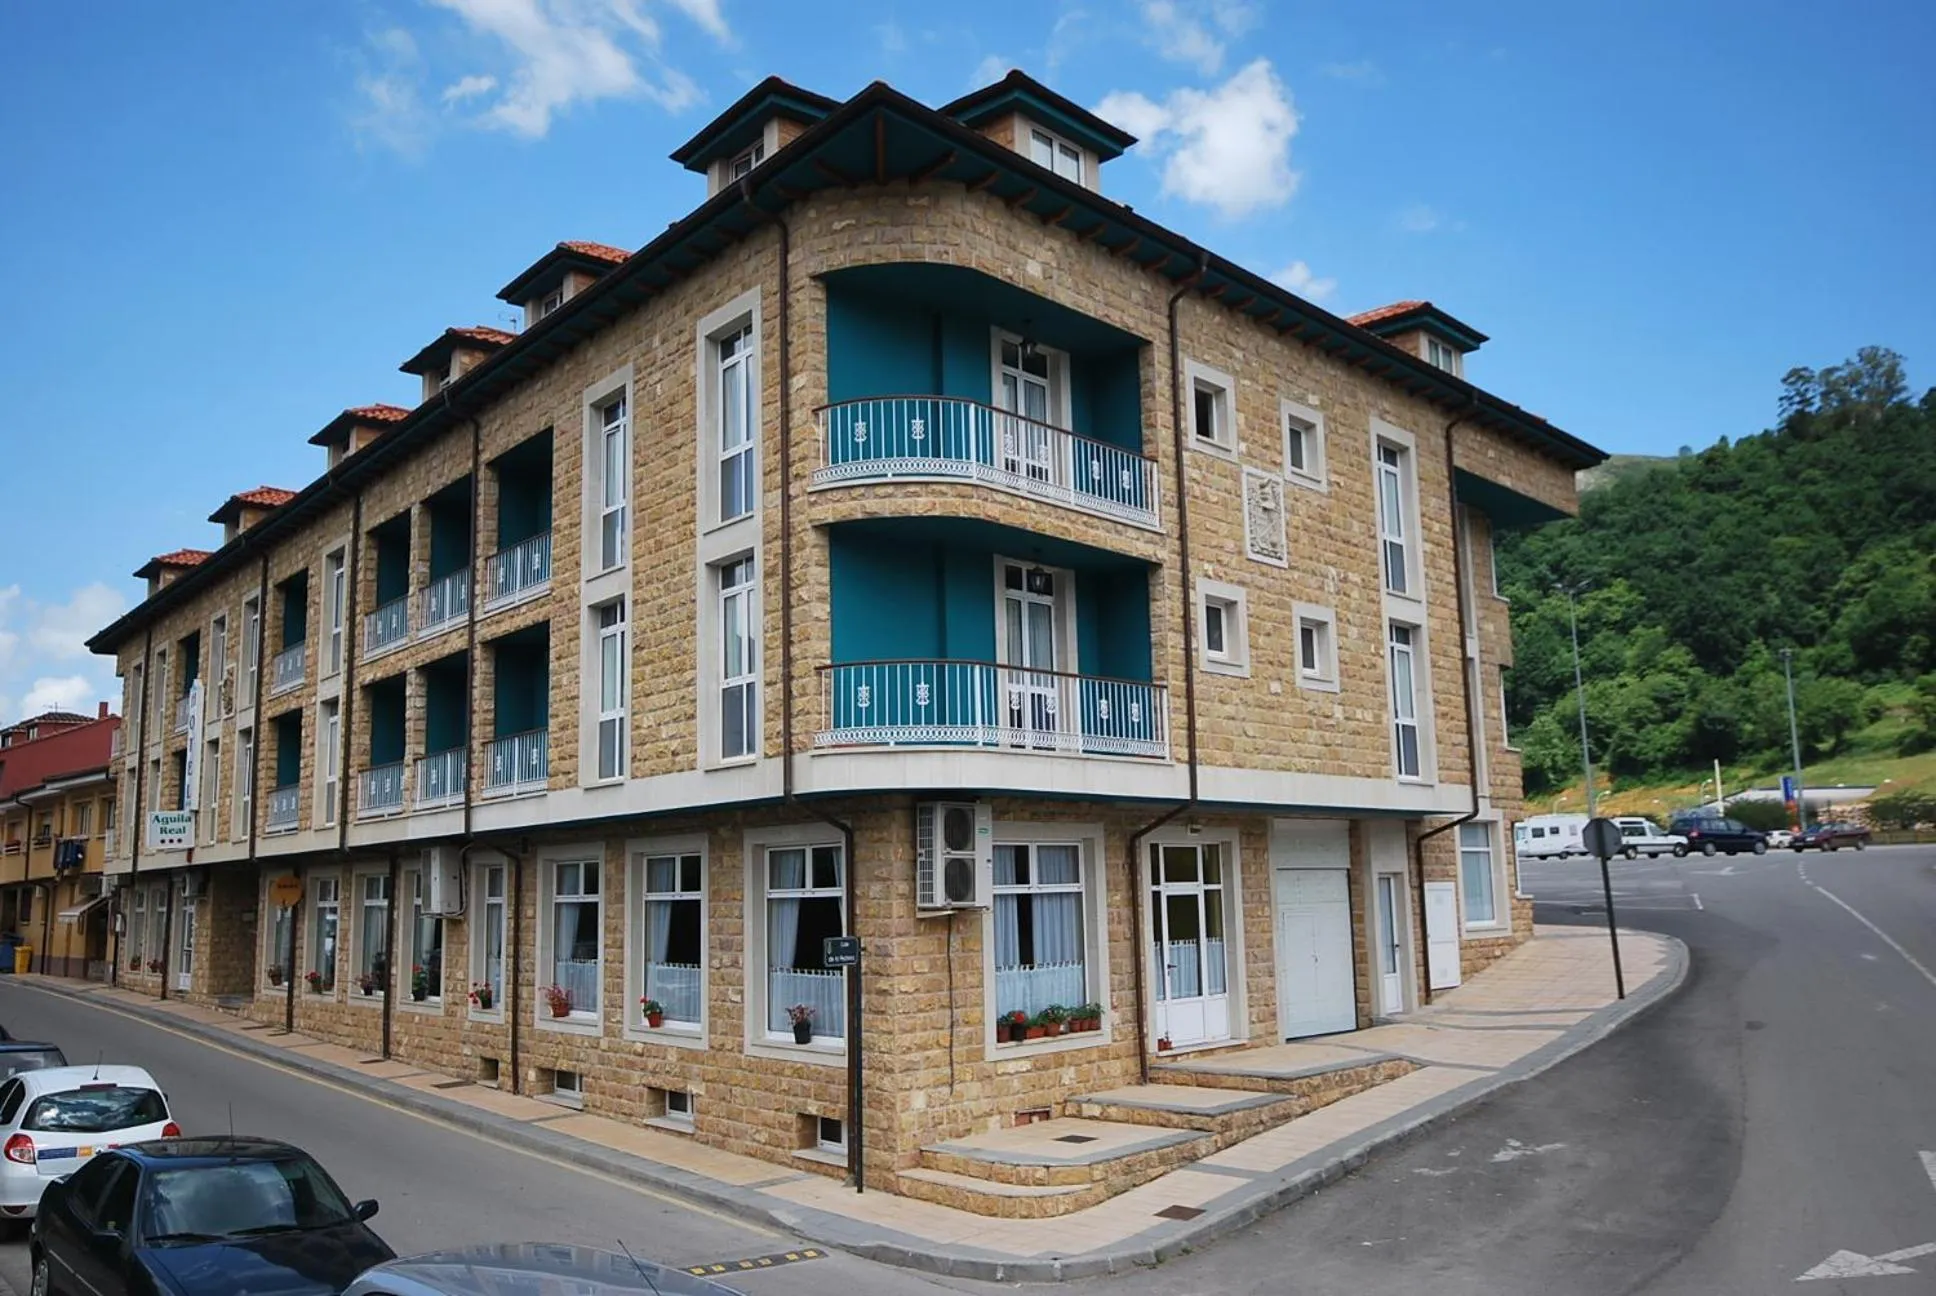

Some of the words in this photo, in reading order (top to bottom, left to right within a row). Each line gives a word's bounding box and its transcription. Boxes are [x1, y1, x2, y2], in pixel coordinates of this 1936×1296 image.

[186, 692, 197, 799] HOTEL
[152, 814, 192, 825] Aguila
[160, 826, 186, 834] Real
